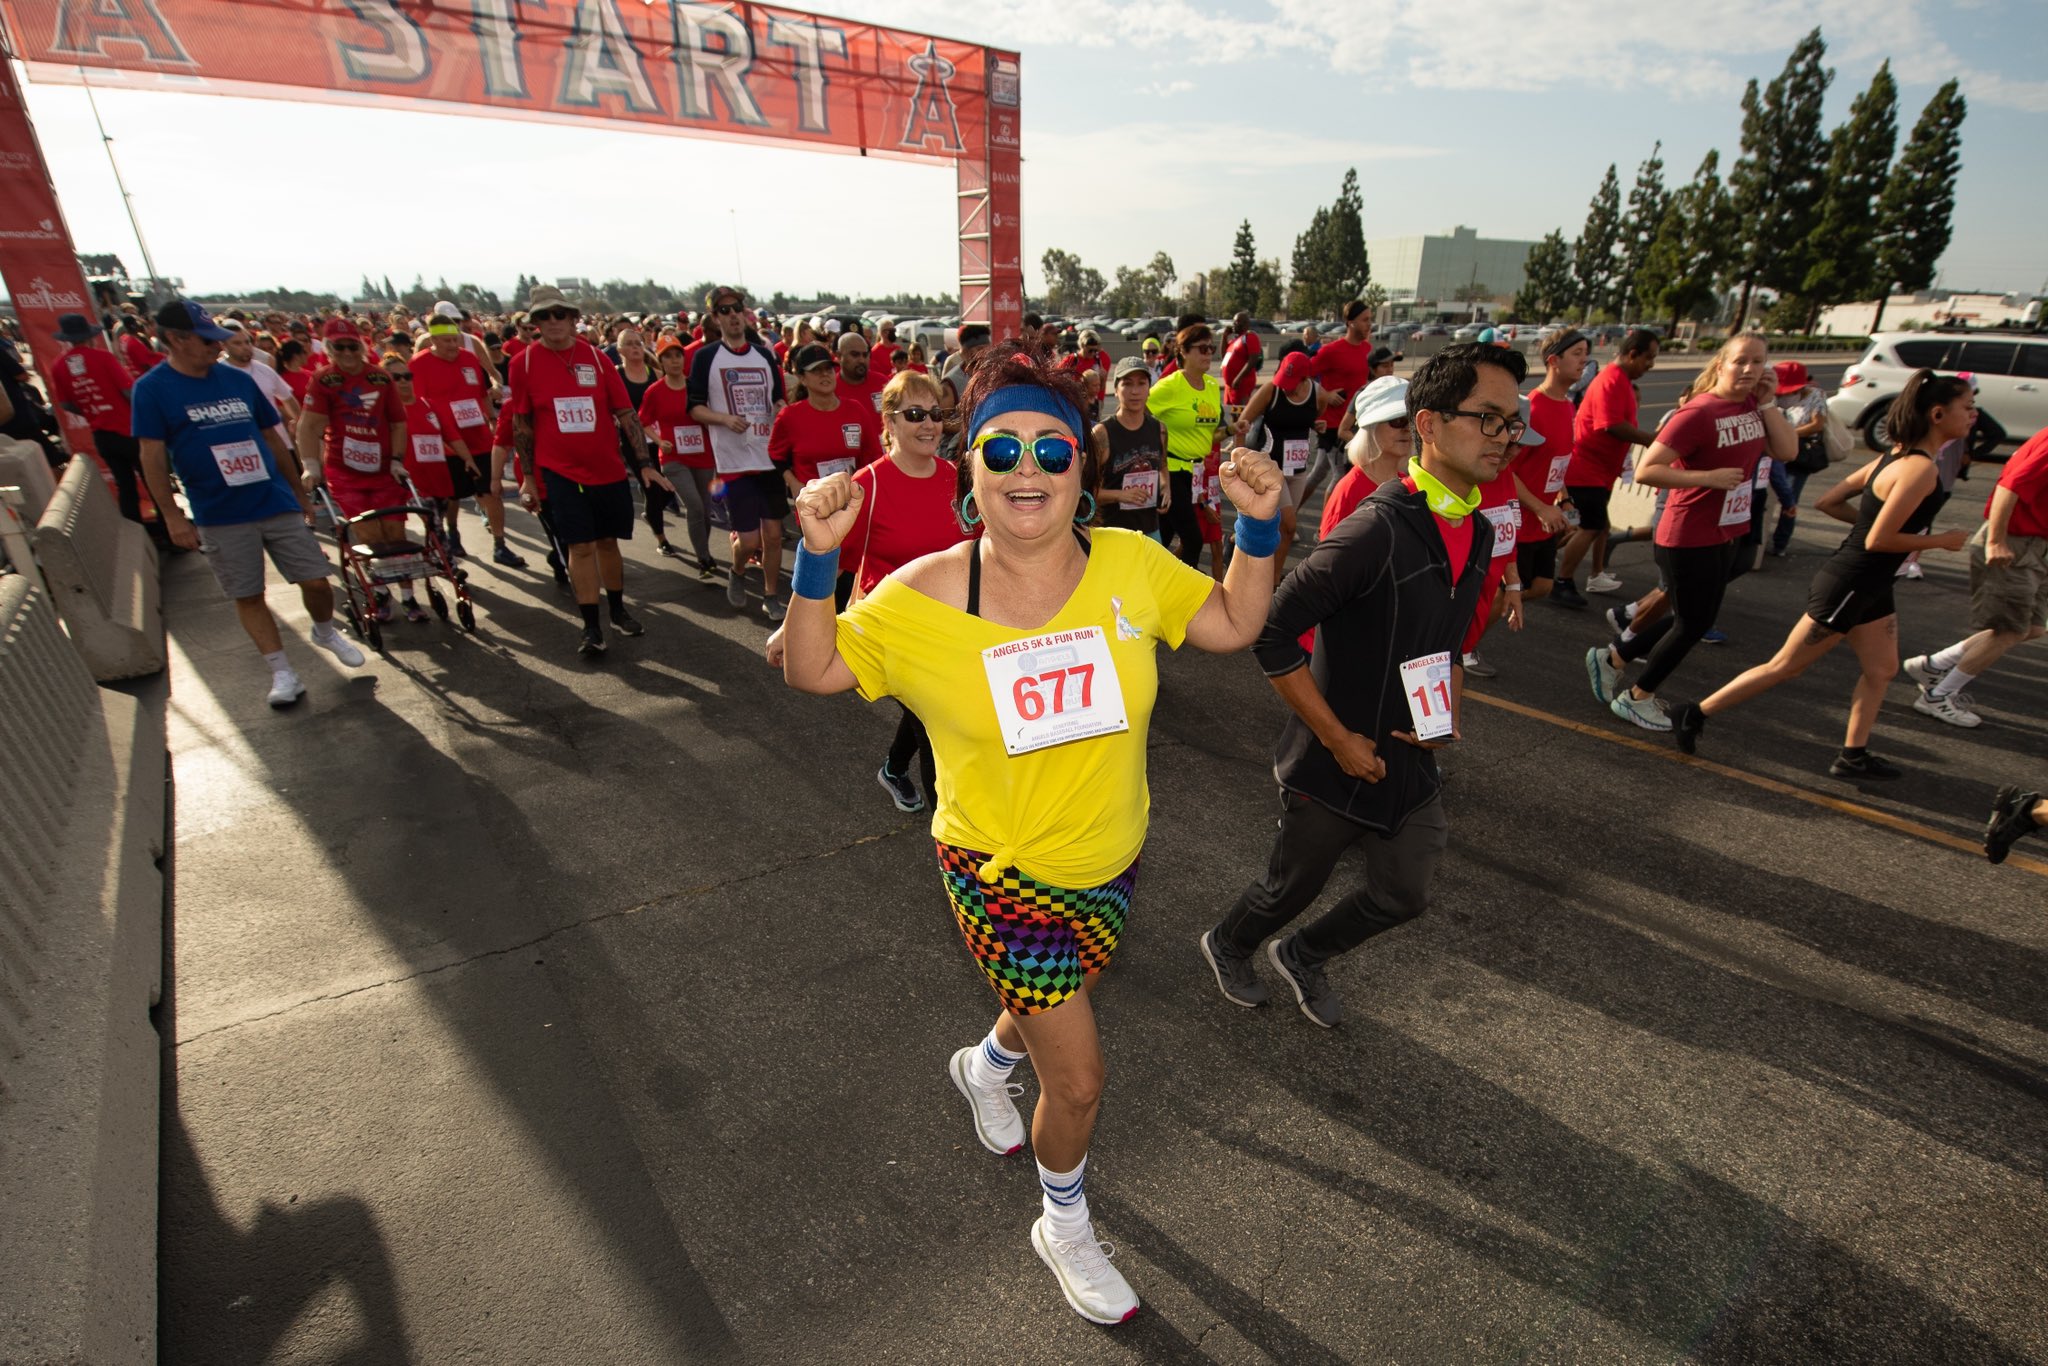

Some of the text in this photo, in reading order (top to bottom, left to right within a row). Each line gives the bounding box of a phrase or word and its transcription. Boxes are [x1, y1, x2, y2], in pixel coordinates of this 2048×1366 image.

[336, 0, 848, 134] START
[558, 408, 595, 423] 3113
[345, 424, 377, 436] PAULA
[677, 434, 702, 447] 1905
[345, 448, 378, 464] 2866
[419, 443, 440, 455] 876
[1285, 448, 1309, 461] 1532
[220, 454, 260, 475] 3497
[1494, 522, 1514, 543] 39
[993, 629, 1094, 658] ANGELS 5K & FUN RUN
[1408, 657, 1435, 671] ANGELS
[1435, 654, 1444, 663] 5K
[1012, 663, 1095, 721] 677
[1411, 680, 1451, 717] 11
[1074, 722, 1102, 732] FOUNDATION
